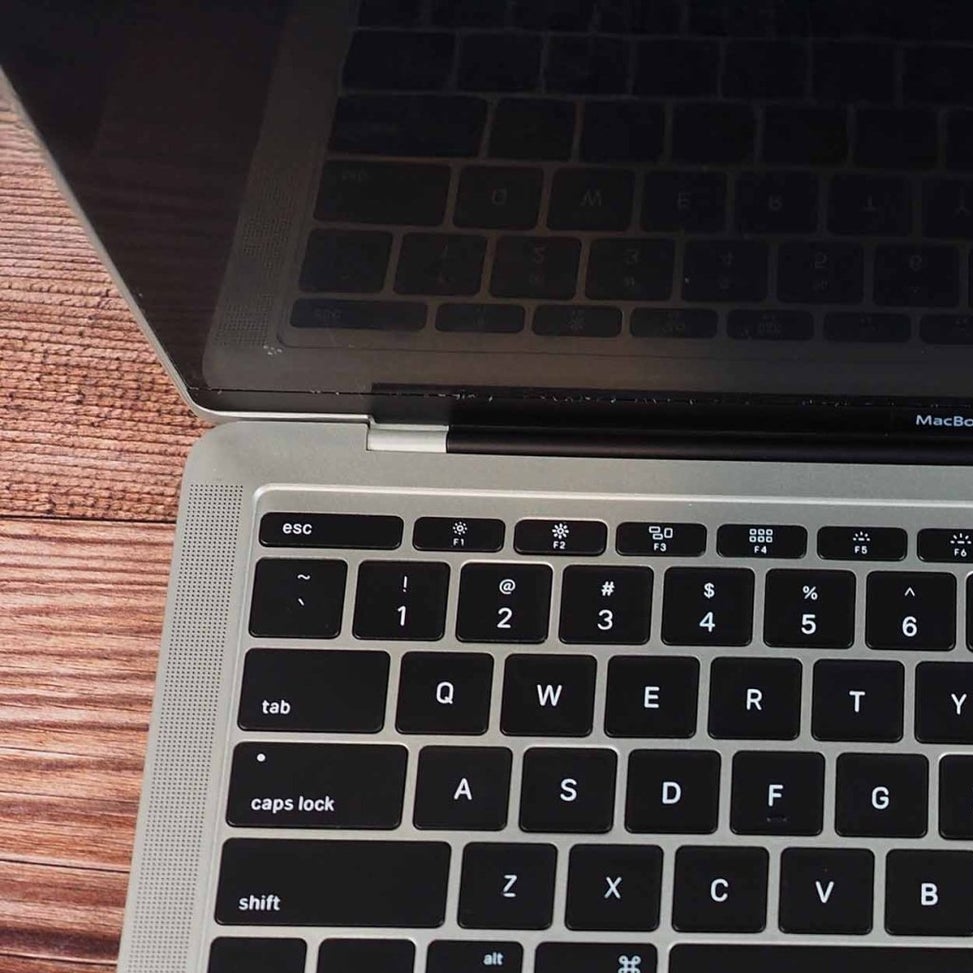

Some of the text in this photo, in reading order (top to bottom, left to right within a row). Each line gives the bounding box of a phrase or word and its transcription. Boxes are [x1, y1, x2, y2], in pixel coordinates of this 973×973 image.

[283, 522, 312, 535] esc
[452, 537, 465, 546] F1
[552, 540, 566, 550] F2
[653, 542, 667, 552] F3
[753, 545, 768, 554] F4
[854, 545, 868, 555] F5
[953, 547, 968, 558] F6
[402, 576, 409, 592] !
[499, 579, 515, 594] @
[600, 581, 615, 596] #
[703, 583, 715, 598] $
[803, 586, 817, 600] %
[396, 606, 407, 626] 1
[497, 608, 512, 628] 2
[598, 610, 613, 630] 3
[700, 612, 715, 632] 4
[802, 614, 816, 634] 5
[903, 616, 917, 636] 6
[436, 682, 454, 704] Q
[537, 685, 562, 706] W
[644, 687, 659, 708] E
[747, 689, 762, 710] R
[849, 691, 865, 712] T
[262, 700, 290, 714] tab
[951, 694, 967, 714] Y
[454, 778, 472, 800] A
[560, 779, 577, 801] S
[663, 782, 681, 804] D
[769, 785, 783, 806] F
[872, 787, 889, 809] G
[251, 796, 334, 813] caps lock
[503, 875, 518, 898] Z
[605, 877, 621, 898] X
[711, 879, 728, 902] C
[816, 881, 834, 903] V
[921, 883, 938, 905] B
[239, 895, 280, 910] shift
[484, 951, 503, 966] alt
